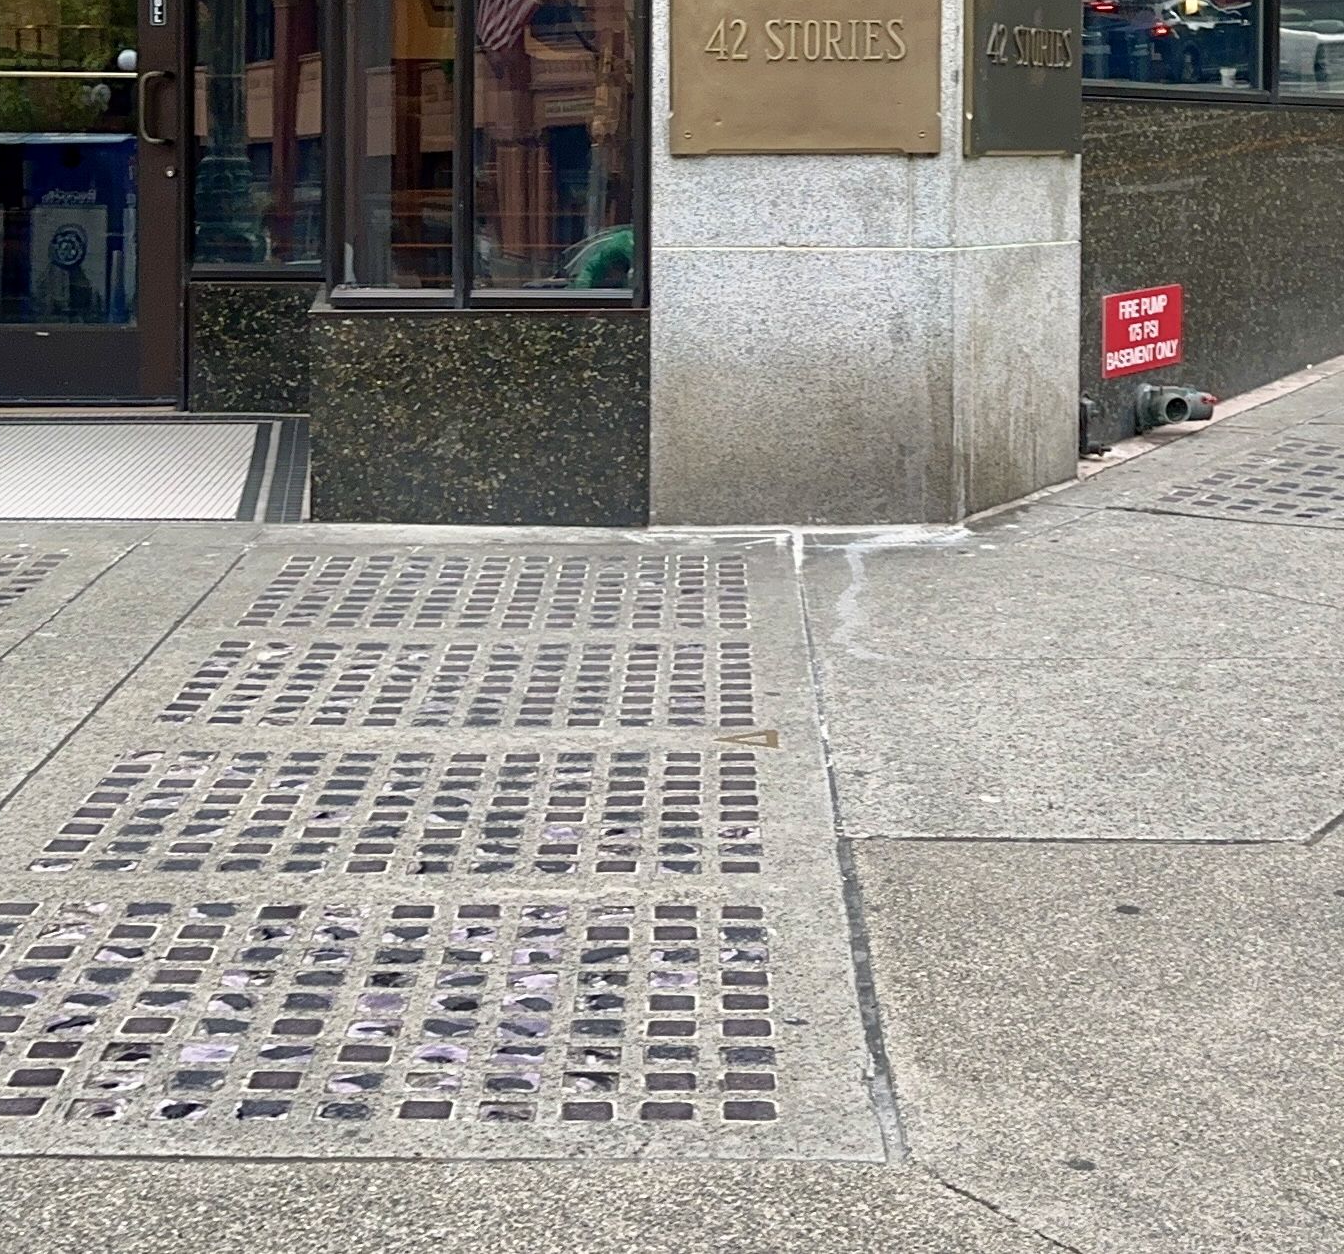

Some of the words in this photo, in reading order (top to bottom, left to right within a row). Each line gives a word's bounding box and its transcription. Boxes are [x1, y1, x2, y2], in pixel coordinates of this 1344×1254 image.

[704, 18, 750, 62] 42
[764, 18, 907, 63] STORIES
[986, 22, 1008, 63] 42
[1013, 25, 1073, 68] STORIES
[1118, 299, 1140, 320] FIRE
[1140, 294, 1168, 316] PUMP
[1143, 319, 1159, 339] PSI
[1106, 343, 1155, 370] BASEMENT
[1156, 338, 1178, 360] ONLY
